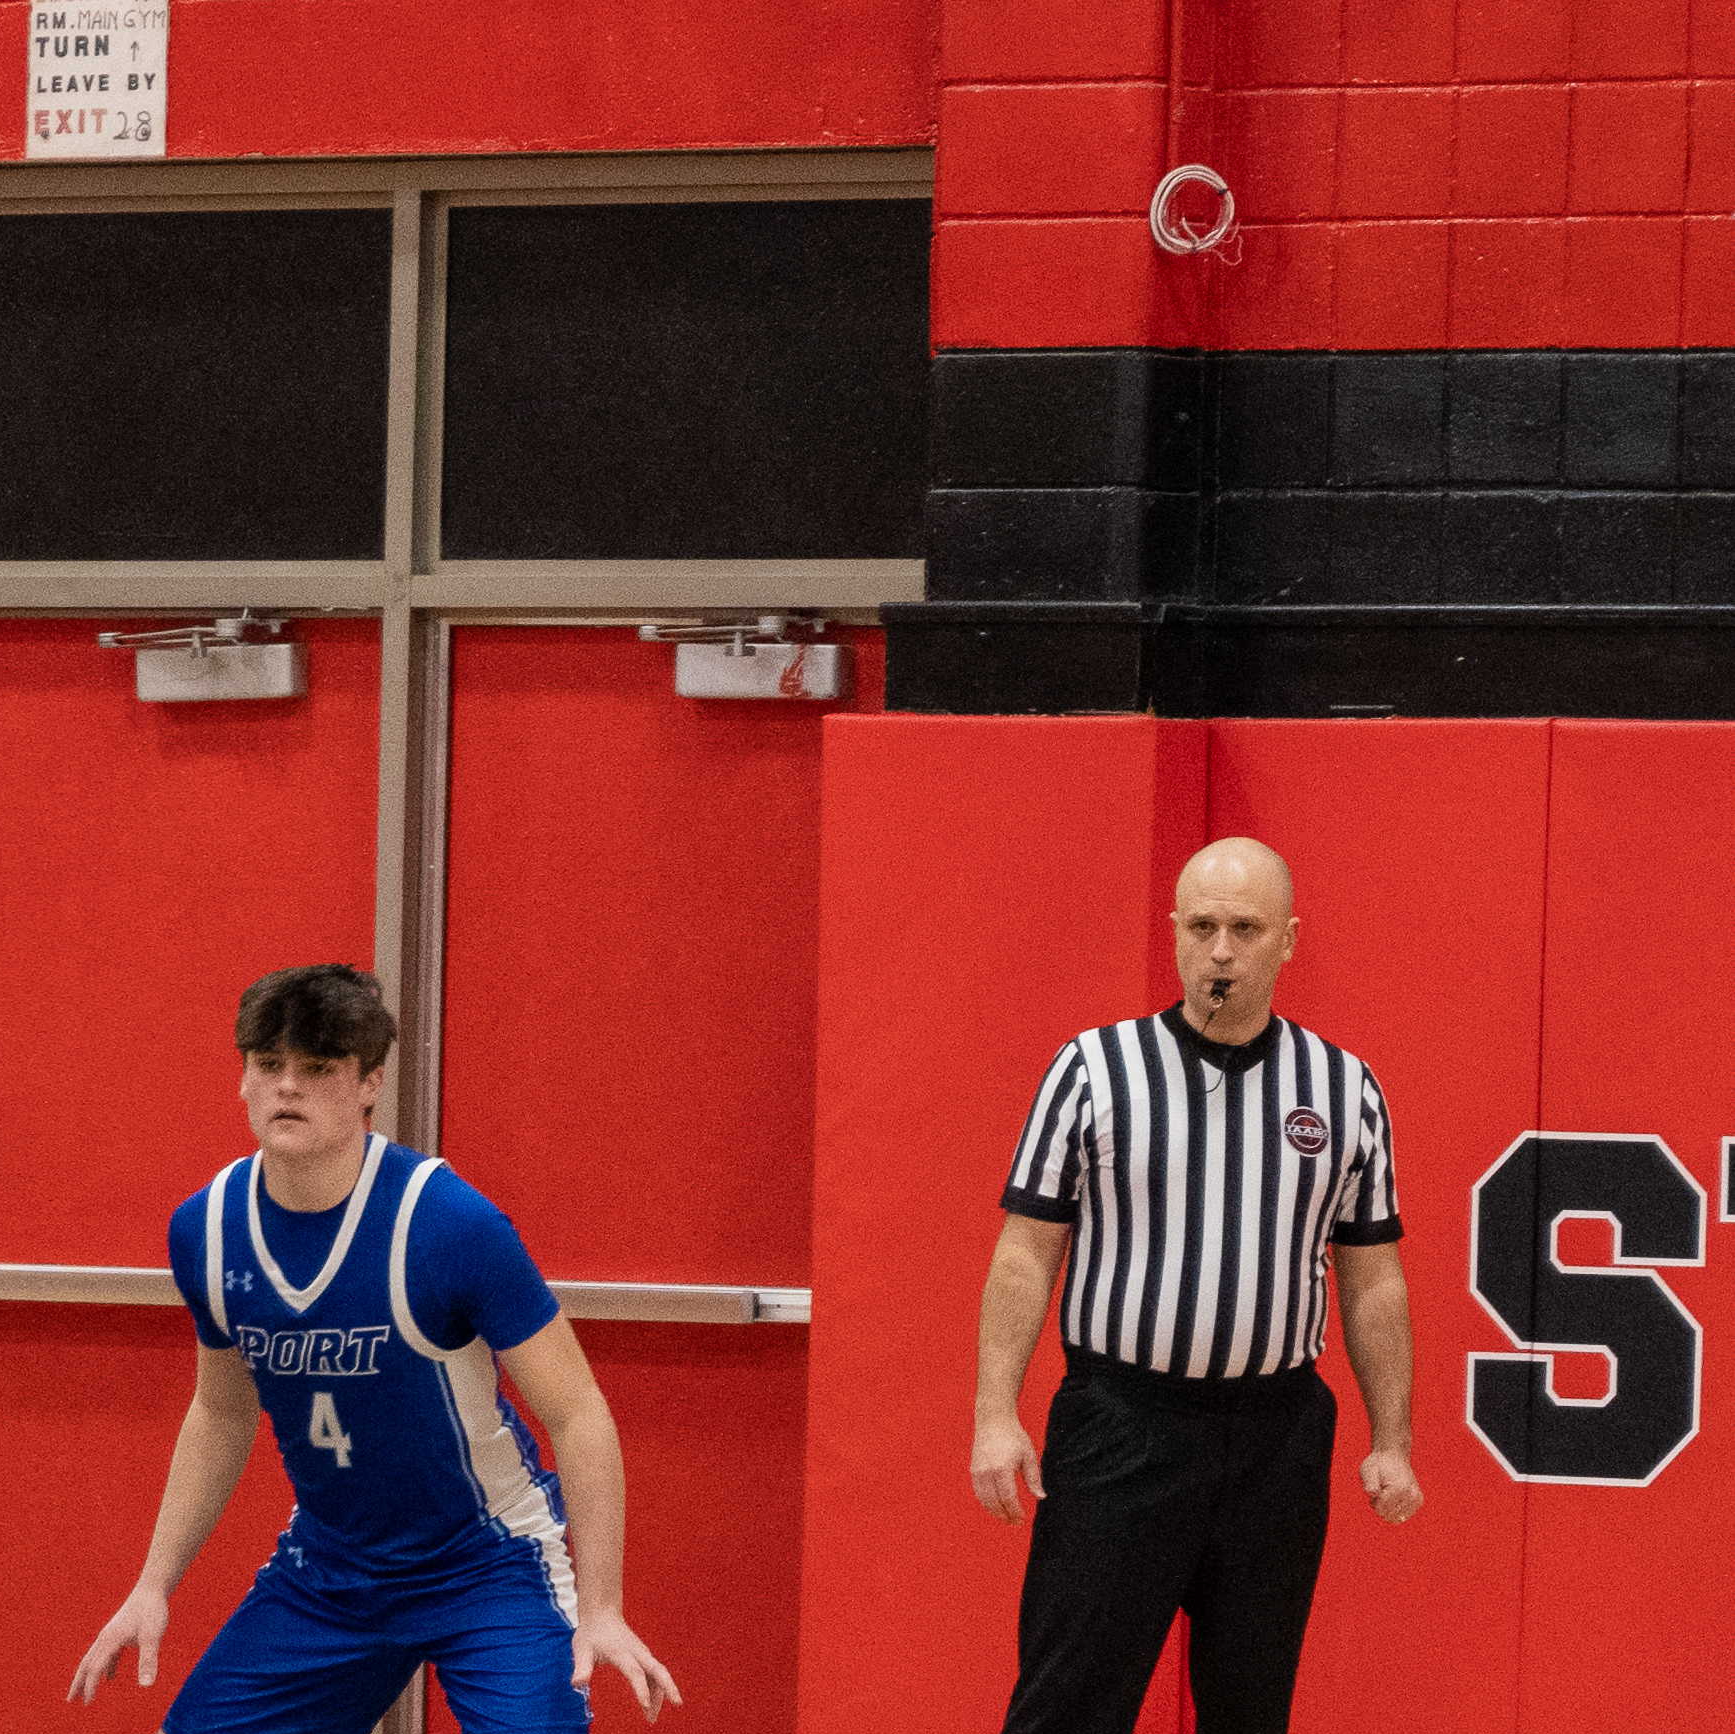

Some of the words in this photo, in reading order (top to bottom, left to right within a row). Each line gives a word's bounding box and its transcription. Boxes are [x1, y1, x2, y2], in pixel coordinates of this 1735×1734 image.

[77, 10, 119, 30] MAIN
[123, 9, 166, 29] GYM
[35, 34, 110, 57] TURN
[37, 74, 110, 93] LEAVE
[127, 73, 156, 91] BY
[34, 108, 108, 136] EXIT
[1466, 1130, 1735, 1487] S
[235, 1324, 391, 1376] PORT
[308, 1391, 353, 1468] 4
